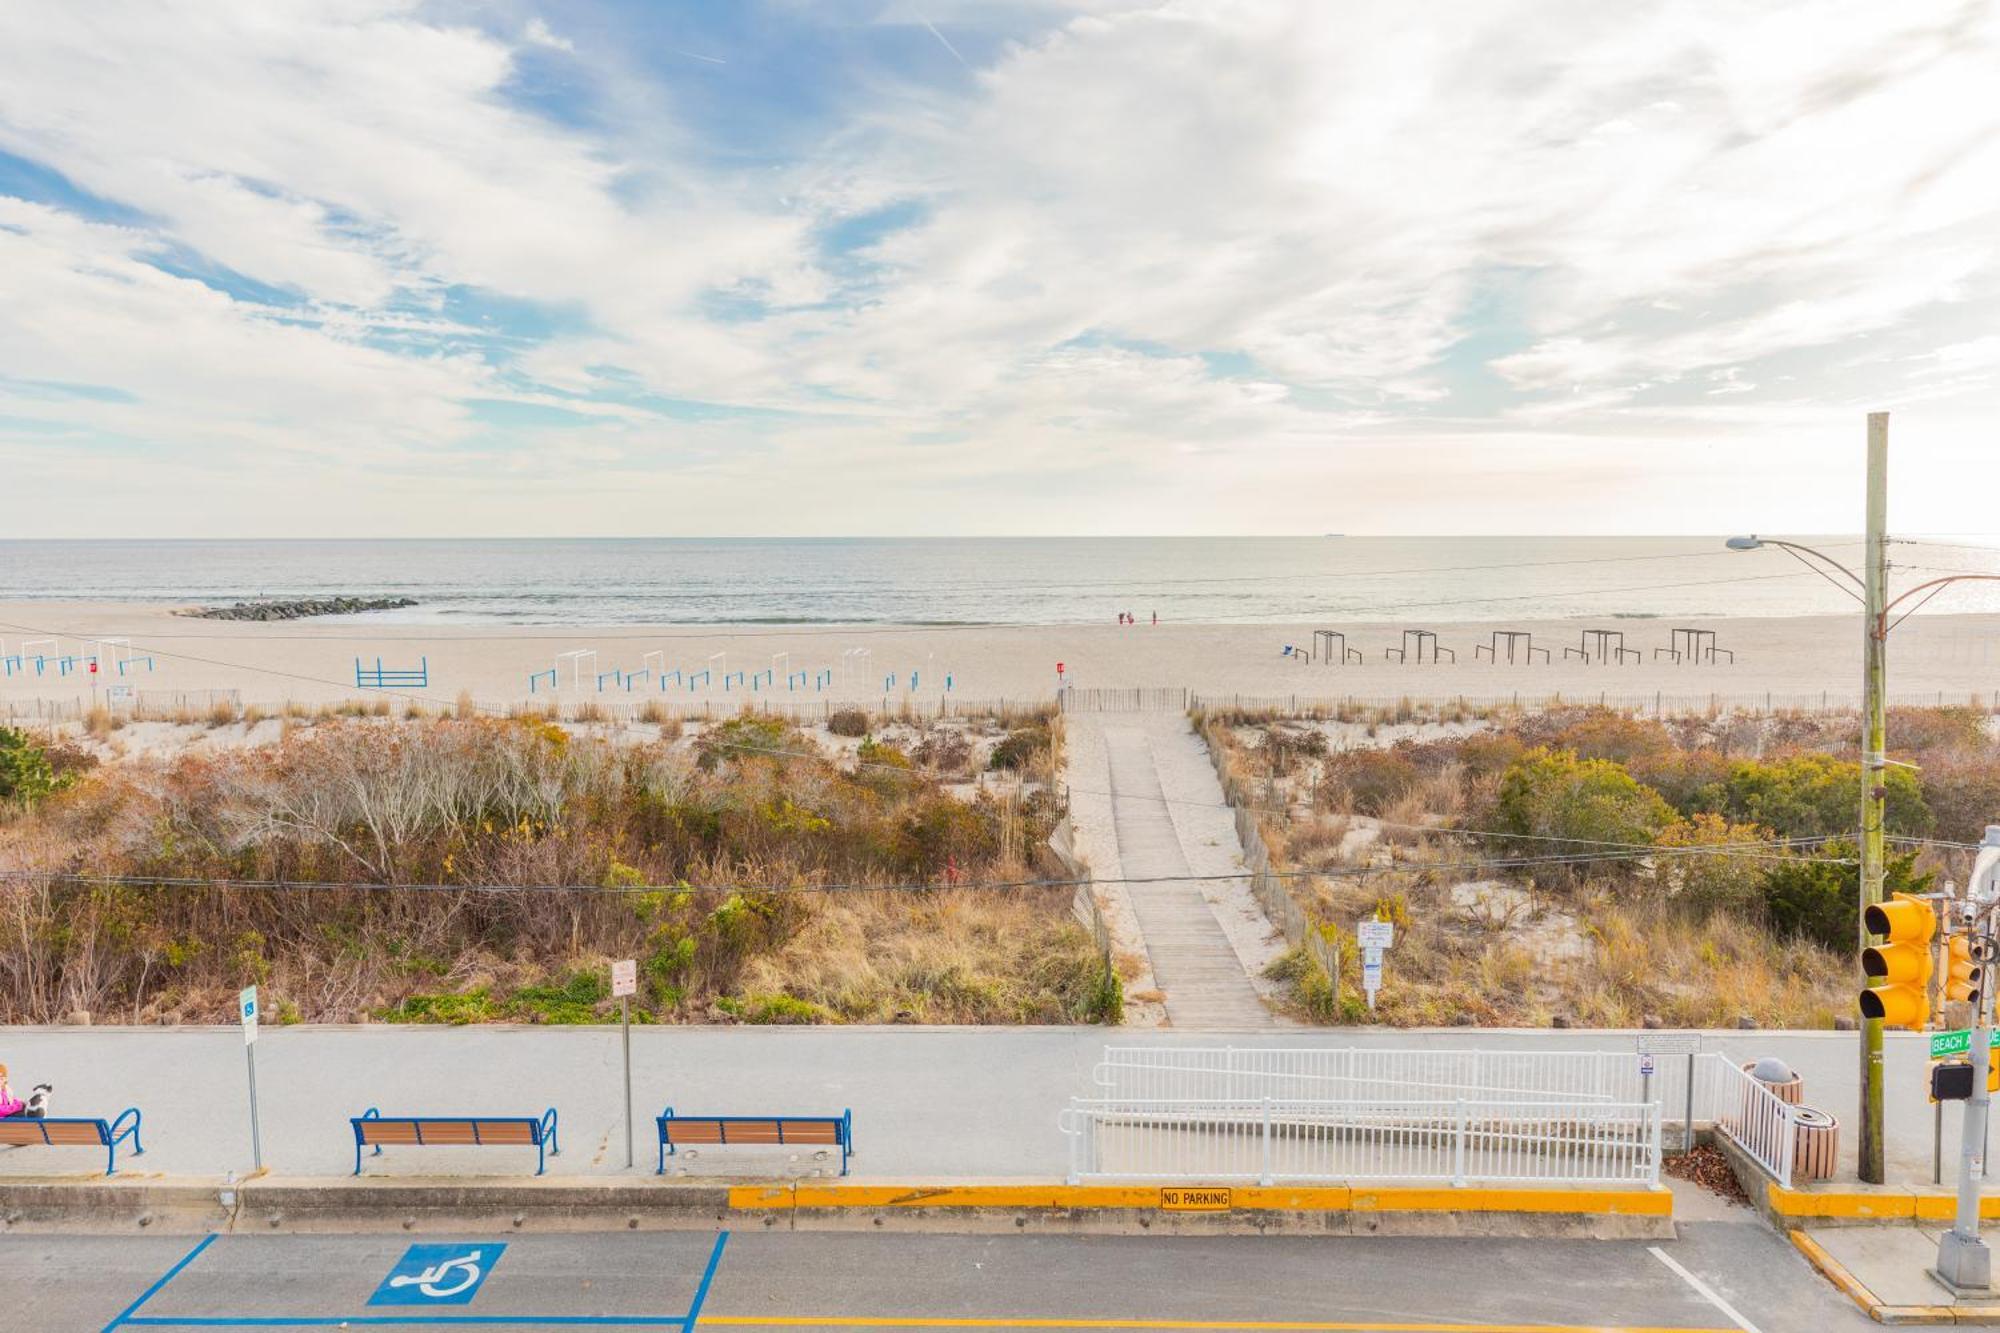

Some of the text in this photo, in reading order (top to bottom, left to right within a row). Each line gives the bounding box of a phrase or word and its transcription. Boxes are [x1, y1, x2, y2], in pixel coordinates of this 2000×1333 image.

[1933, 1035, 1962, 1052] BEACH
[1163, 1192, 1228, 1205] NO PARKING
